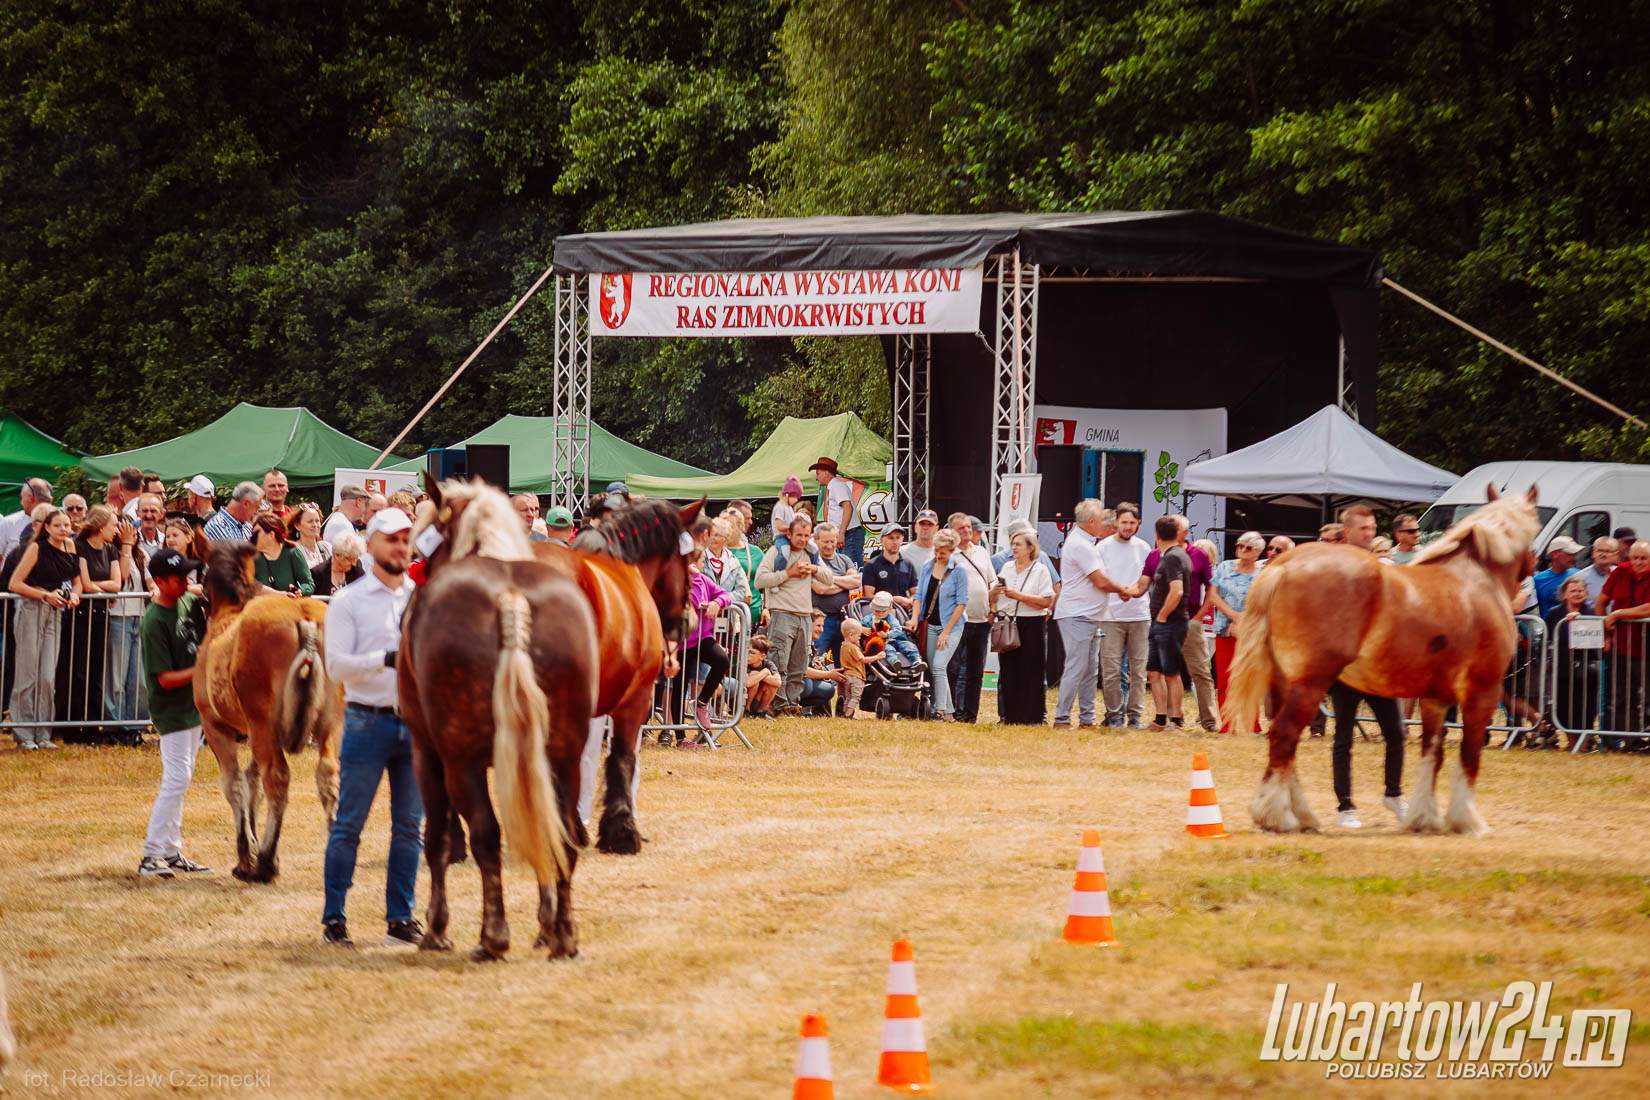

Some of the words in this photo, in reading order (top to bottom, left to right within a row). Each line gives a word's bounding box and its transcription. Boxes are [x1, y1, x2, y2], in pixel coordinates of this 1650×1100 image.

[649, 272, 788, 298] REGIONALNA
[794, 269, 899, 296] WYSTAWA
[904, 267, 964, 294] KONI
[676, 305, 717, 329] RAS
[722, 301, 927, 329] ZIMNOKRWISTYCH
[1086, 427, 1120, 442] GMINA
